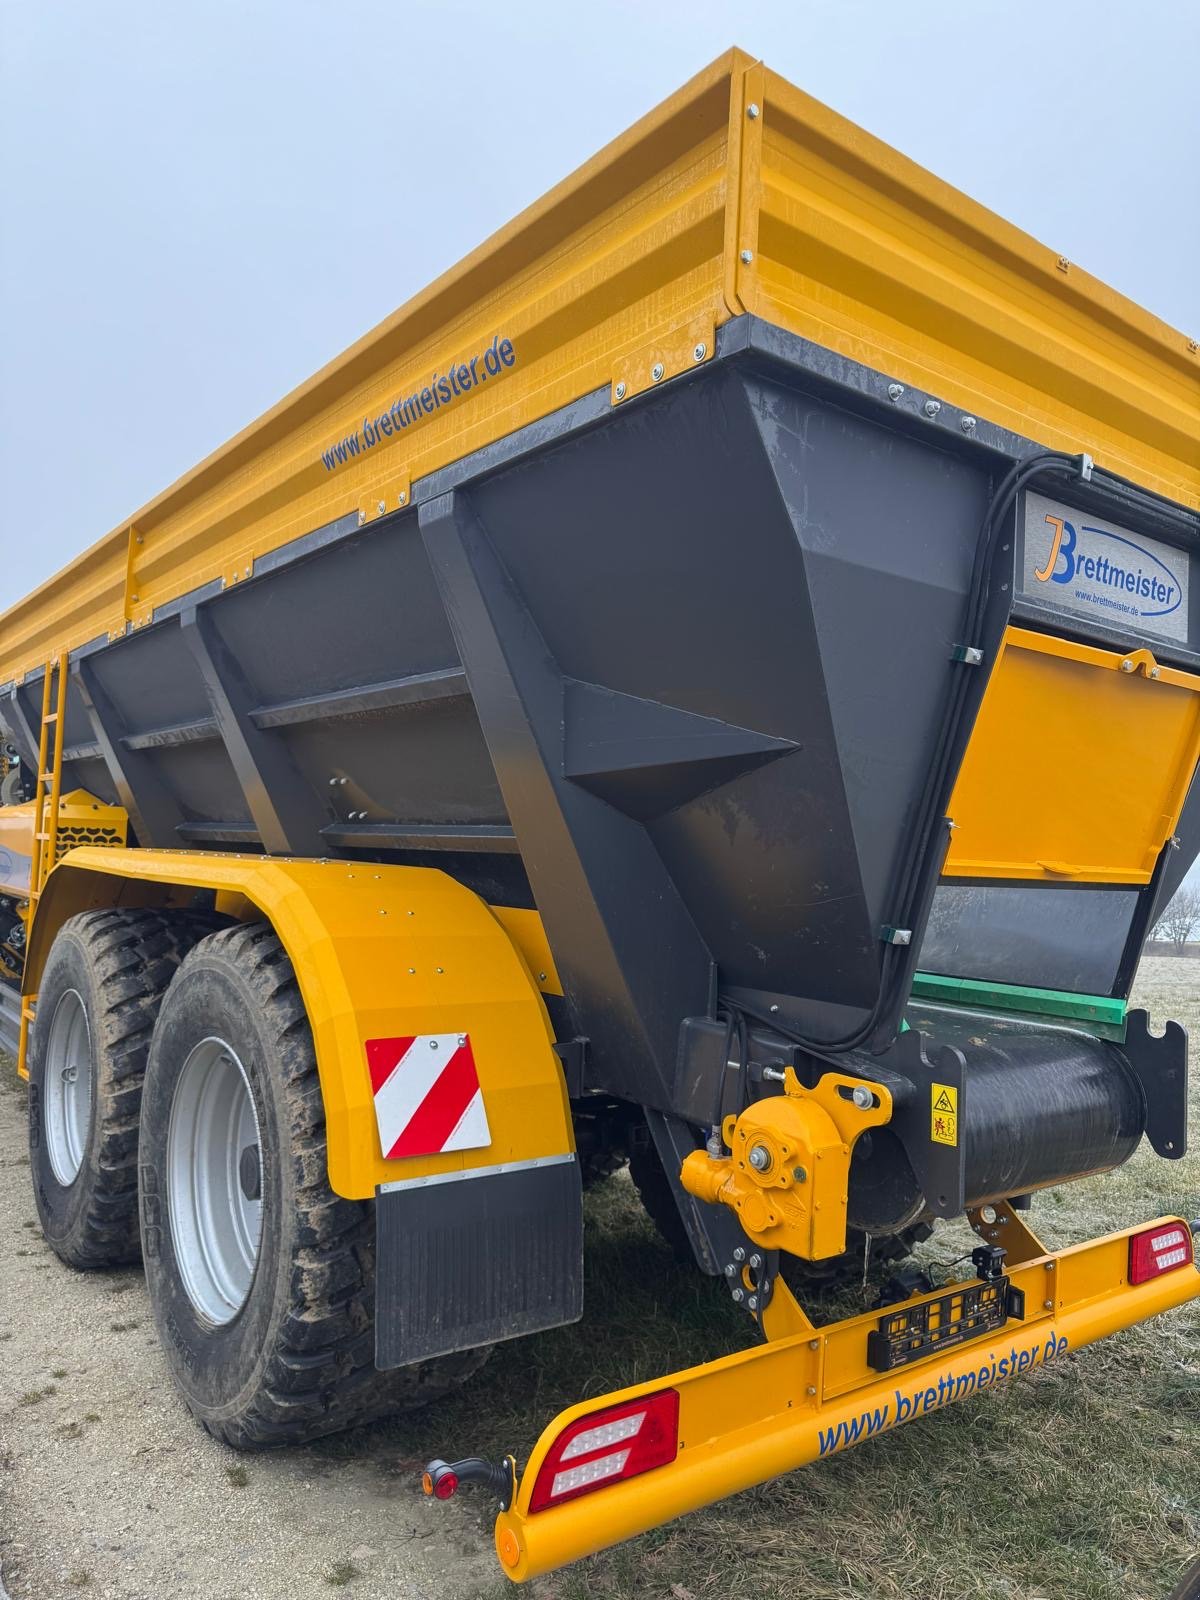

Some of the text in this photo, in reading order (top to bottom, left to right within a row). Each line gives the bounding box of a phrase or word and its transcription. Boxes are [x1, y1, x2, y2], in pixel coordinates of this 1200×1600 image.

[321, 336, 515, 471] www.brettmeister.de
[1075, 589, 1139, 616] www.brettmeister.de
[818, 1331, 1069, 1455] www.brettmeister.de
